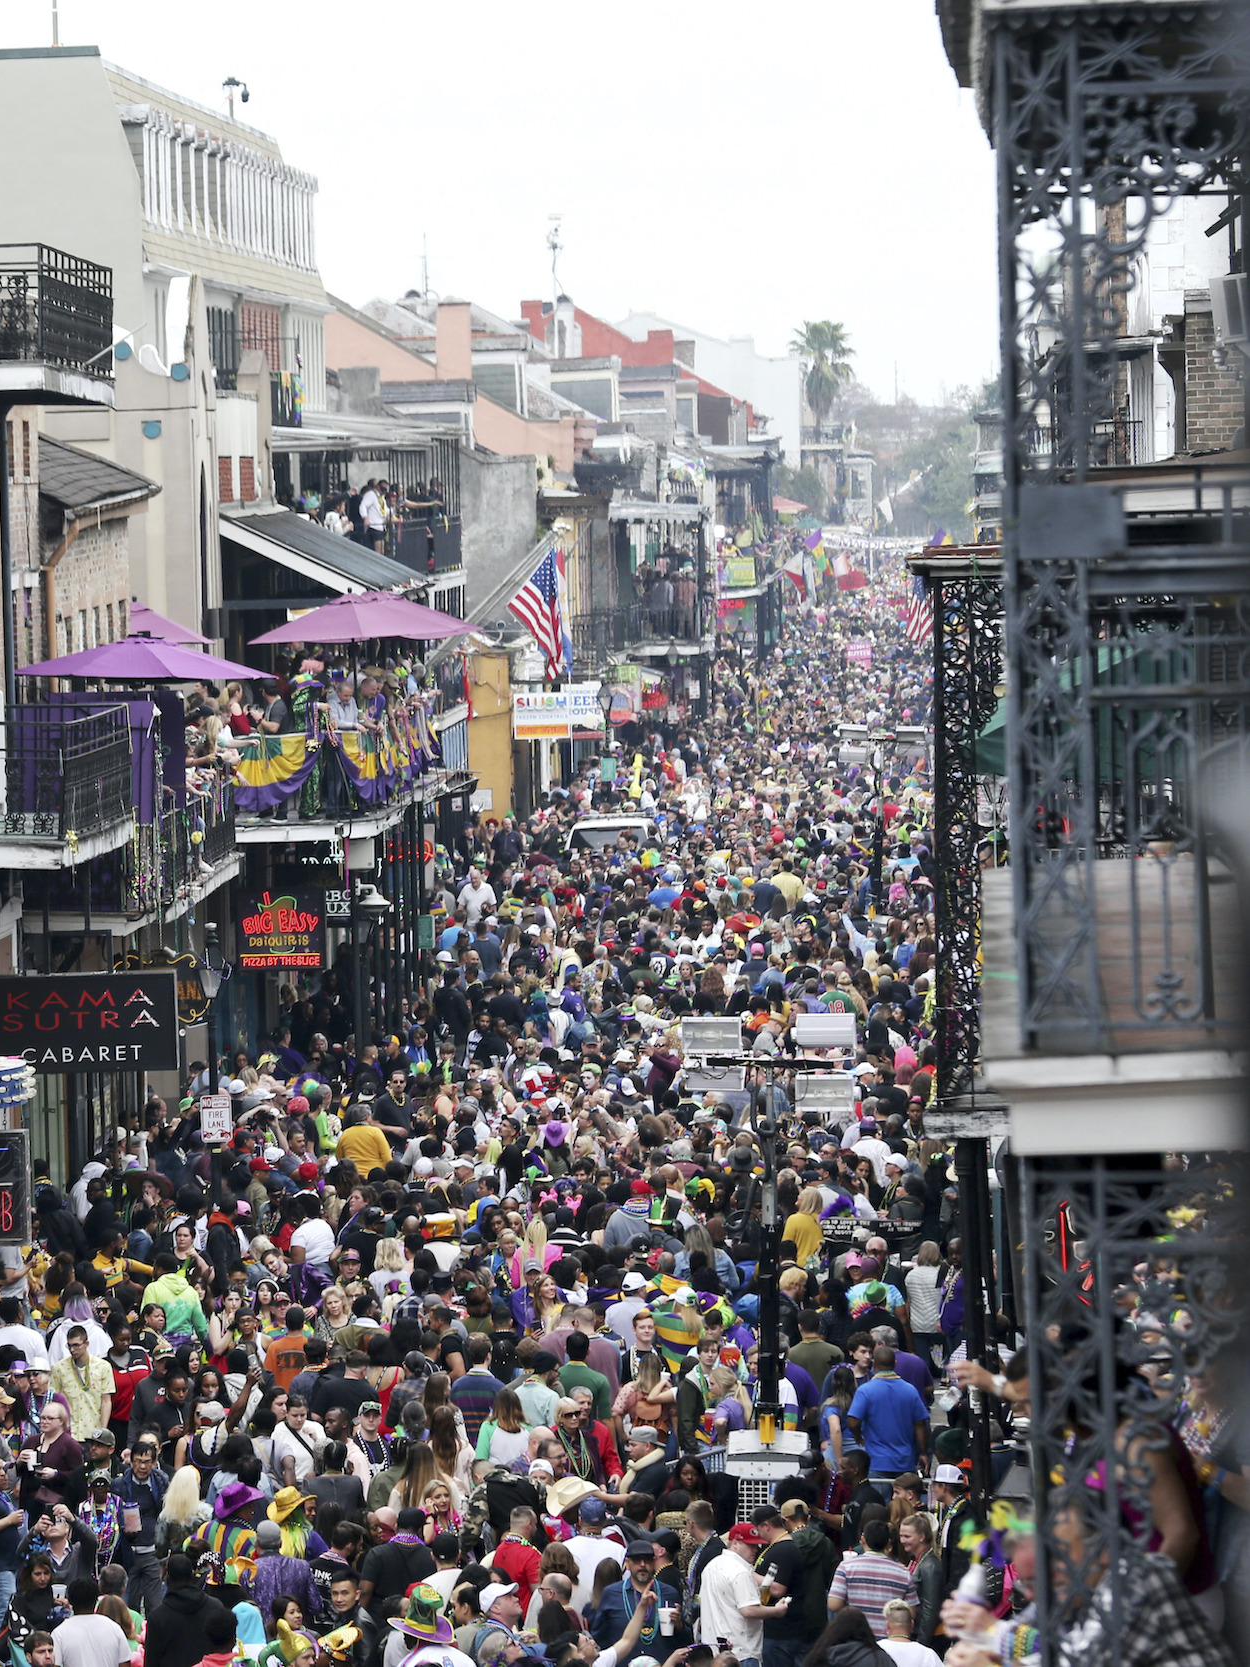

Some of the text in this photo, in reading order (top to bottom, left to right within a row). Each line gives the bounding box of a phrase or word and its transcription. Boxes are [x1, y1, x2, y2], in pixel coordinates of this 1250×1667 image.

[516, 696, 567, 711] SLUSH
[242, 908, 320, 935] BIG EASY
[242, 956, 267, 967] PIZZA
[267, 956, 279, 966] BY
[6, 988, 155, 1011] KAMA
[828, 1000, 846, 1014] 18
[2, 1009, 161, 1032] SUTRA
[21, 1044, 143, 1065] CABARET
[202, 1098, 212, 1107] NO
[208, 1110, 225, 1118] FIRE
[207, 1120, 226, 1129] LANE
